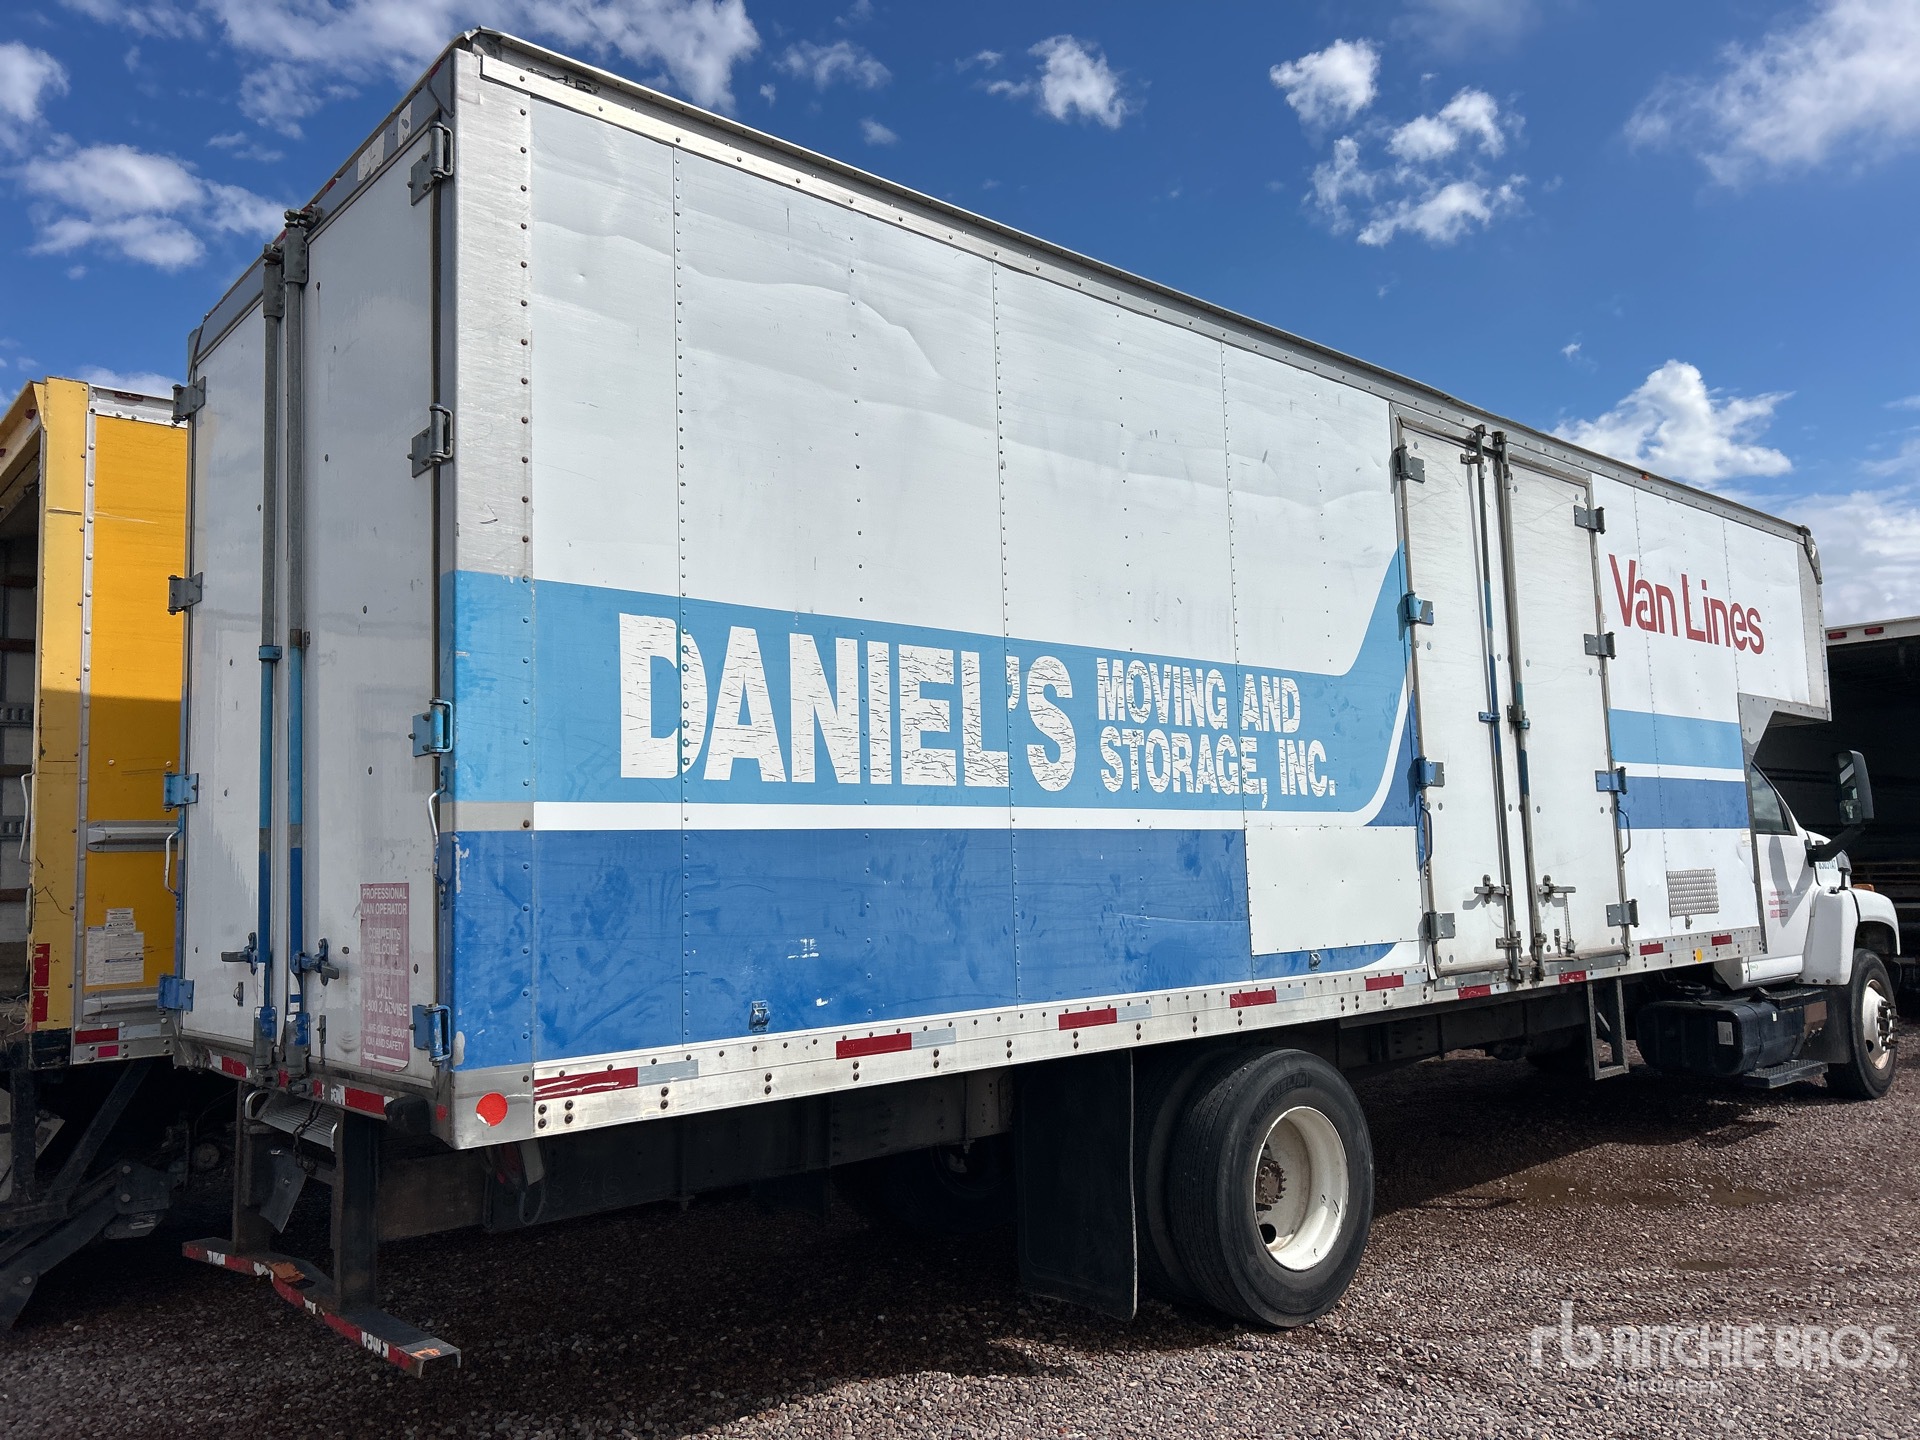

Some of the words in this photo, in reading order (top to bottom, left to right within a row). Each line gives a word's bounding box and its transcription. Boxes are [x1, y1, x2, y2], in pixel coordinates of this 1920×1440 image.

[1608, 553, 1679, 637] Van
[1681, 573, 1765, 655] Lines
[618, 612, 1077, 793] DANIEL'S
[1096, 657, 1229, 730] MOVING
[1240, 673, 1301, 734] AND
[1100, 726, 1269, 800] STORAGE,
[1278, 739, 1337, 798] INC.
[362, 887, 407, 900] PROFESSIONAL
[362, 902, 375, 915] VAN
[375, 902, 408, 915] OPERATOR
[367, 927, 401, 940] COMMENTS
[376, 985, 393, 1000] CALL
[379, 1000, 384, 1013] 2
[384, 1001, 408, 1017] ADVISE
[391, 1027, 408, 1040] ABOUT
[386, 1039, 405, 1053] SAFETY
